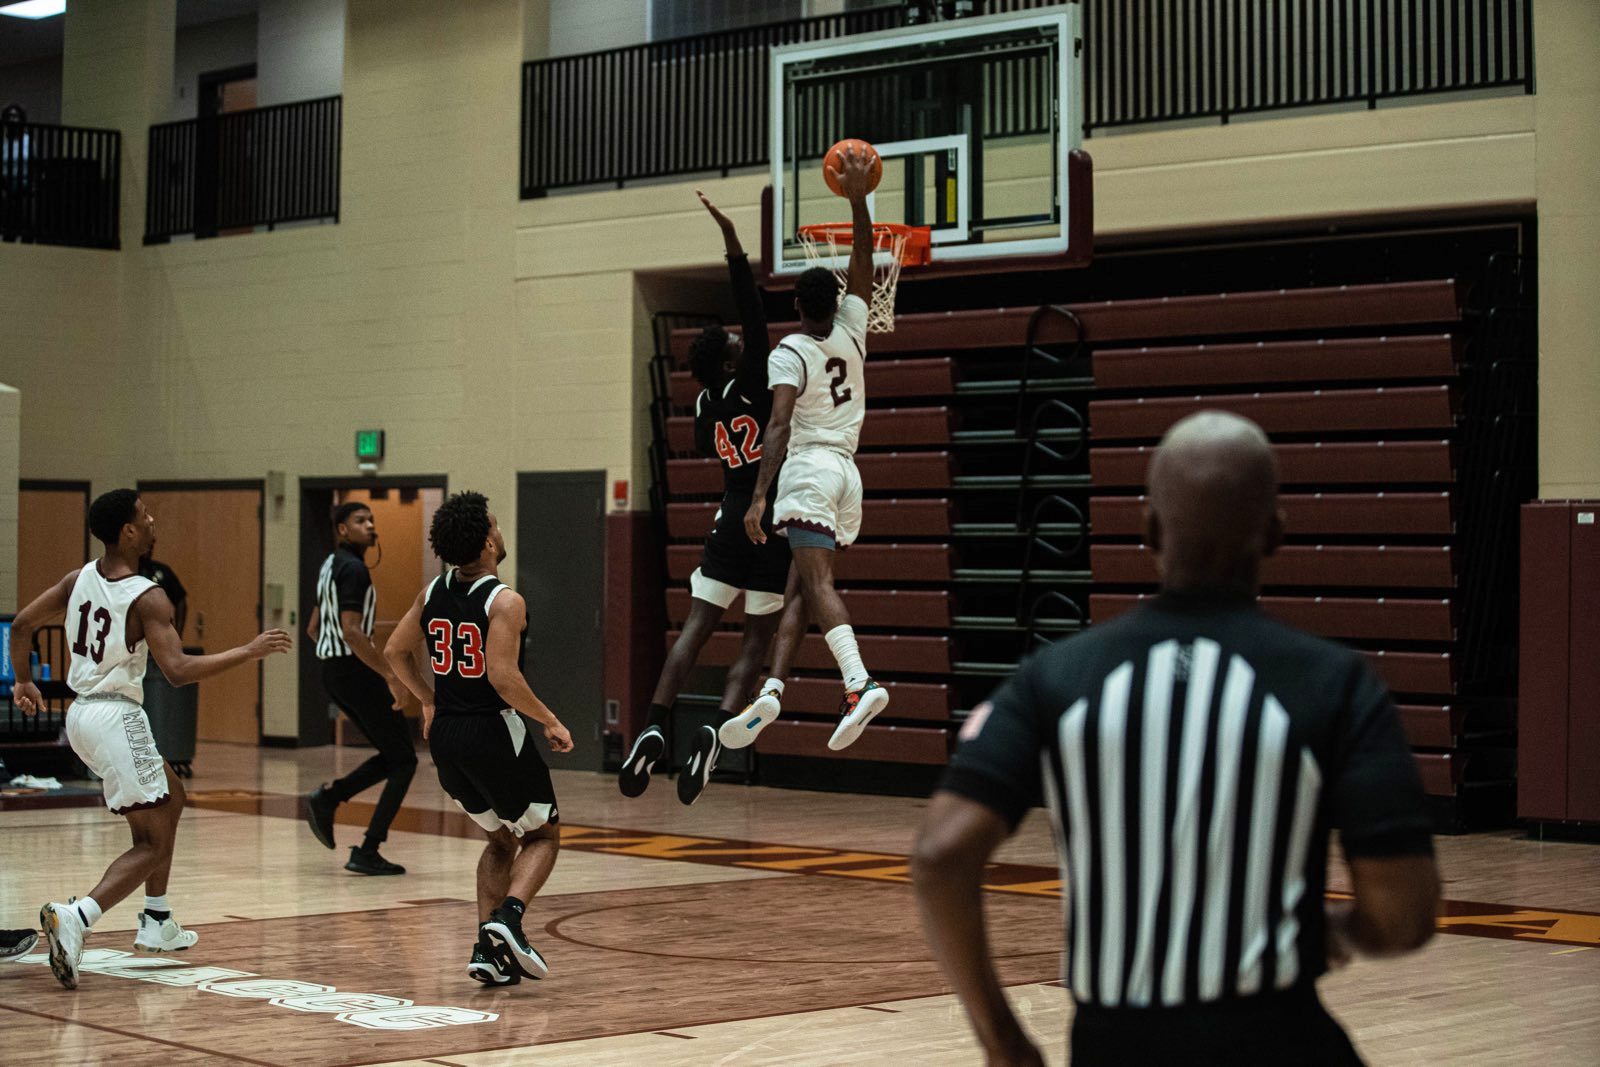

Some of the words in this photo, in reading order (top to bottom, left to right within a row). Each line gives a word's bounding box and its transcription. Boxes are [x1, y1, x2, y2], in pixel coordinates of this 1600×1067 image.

[825, 357, 851, 406] 2
[714, 414, 763, 469] 42
[72, 600, 111, 664] 13
[427, 616, 487, 680] 33
[122, 710, 158, 784] WILDCATS
